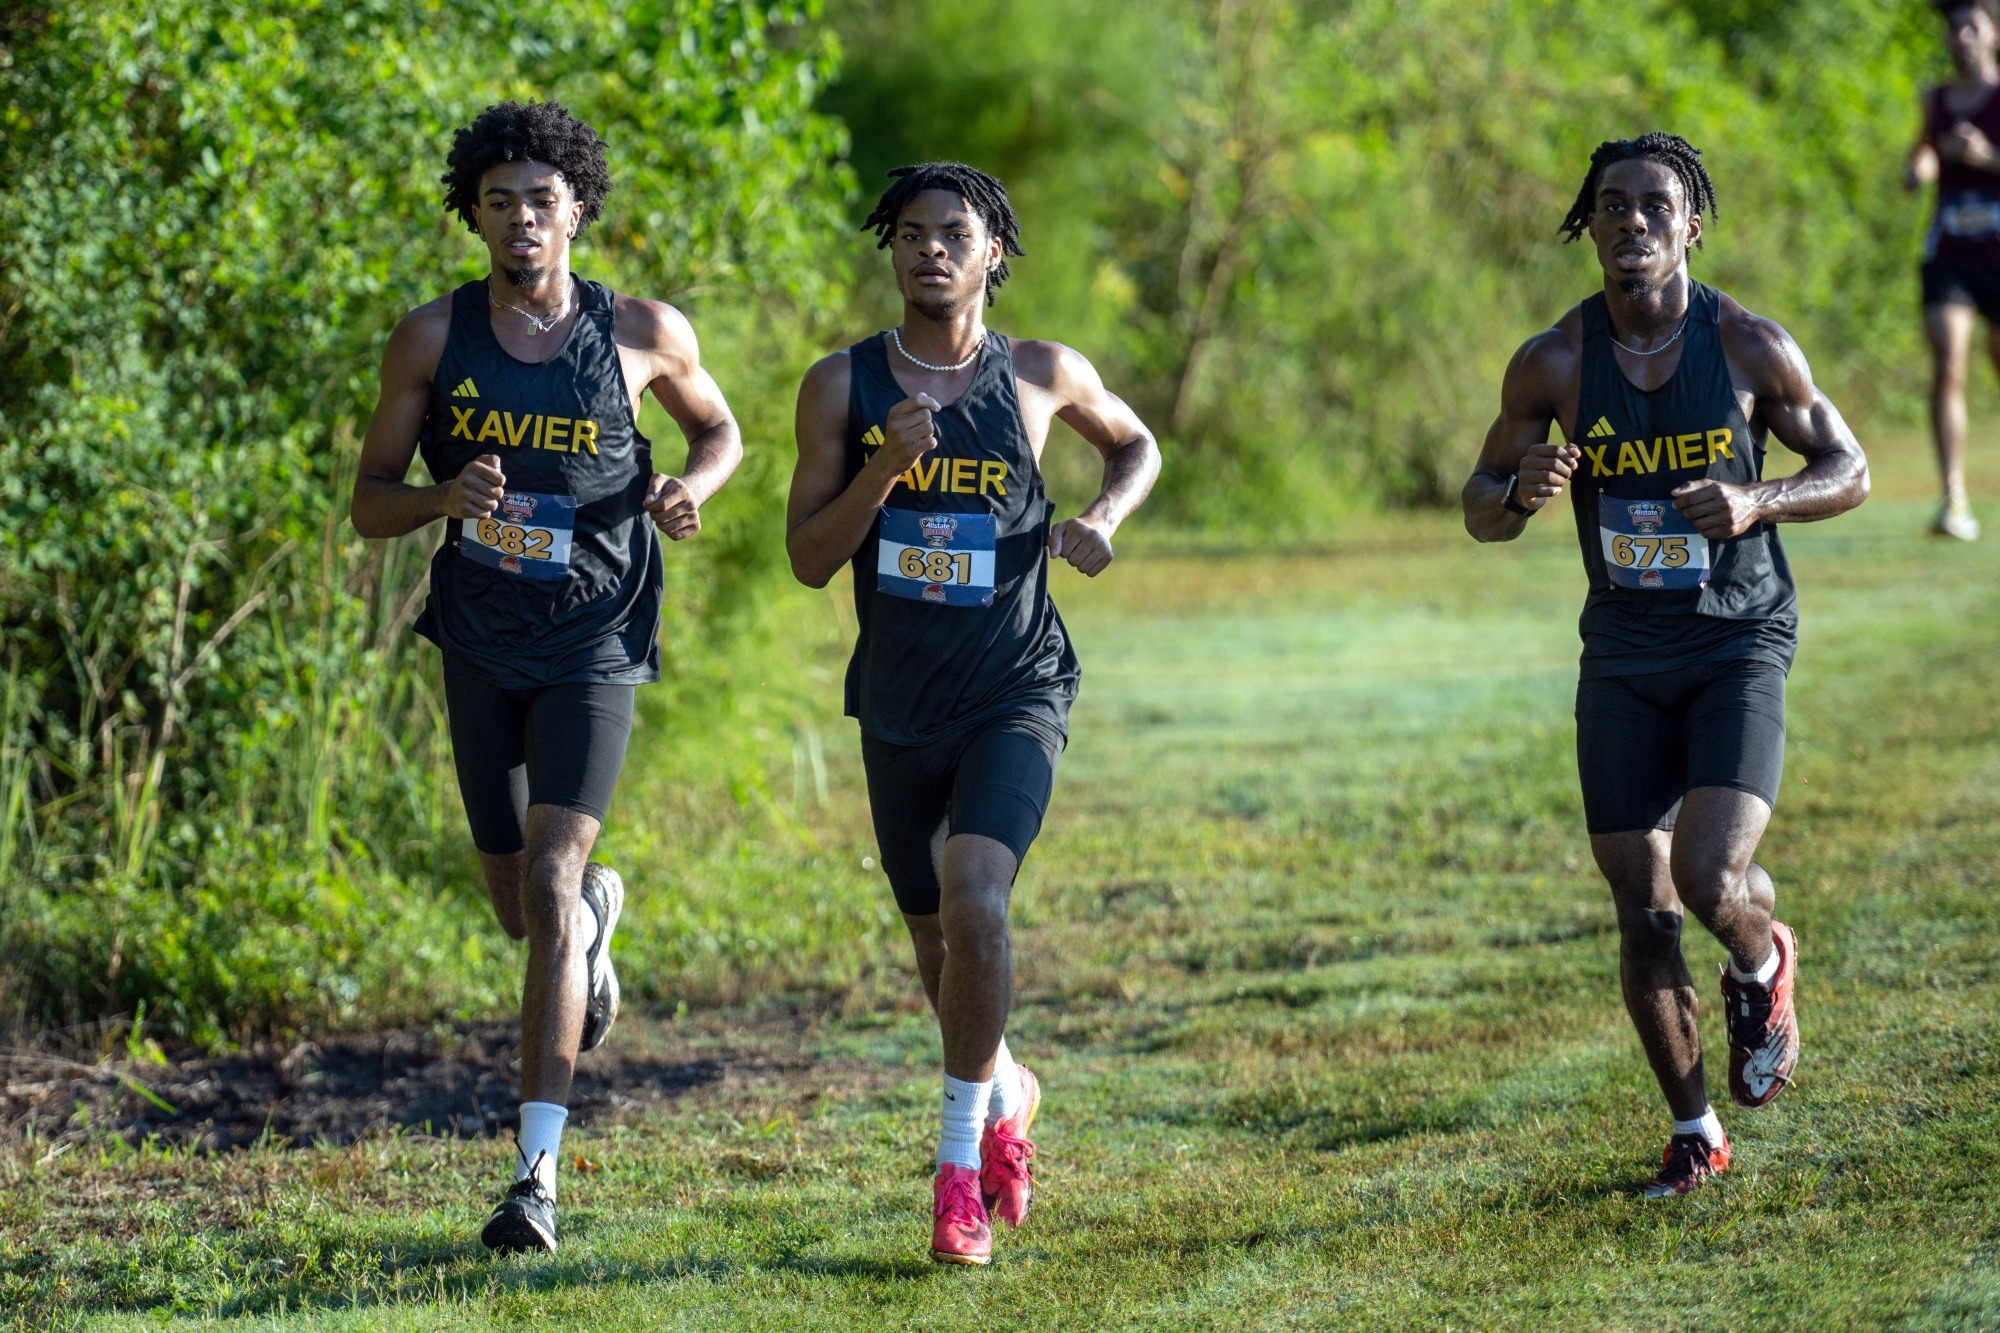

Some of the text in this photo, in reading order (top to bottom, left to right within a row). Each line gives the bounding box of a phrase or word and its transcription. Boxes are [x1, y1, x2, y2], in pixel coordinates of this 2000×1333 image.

[451, 405, 600, 455] XAVIER
[1584, 427, 1735, 477] XAVIER
[864, 452, 1008, 496] VIER
[476, 517, 554, 560] 682
[925, 522, 951, 530] Allstate
[898, 547, 972, 585] 681
[1611, 534, 1691, 569] 675
